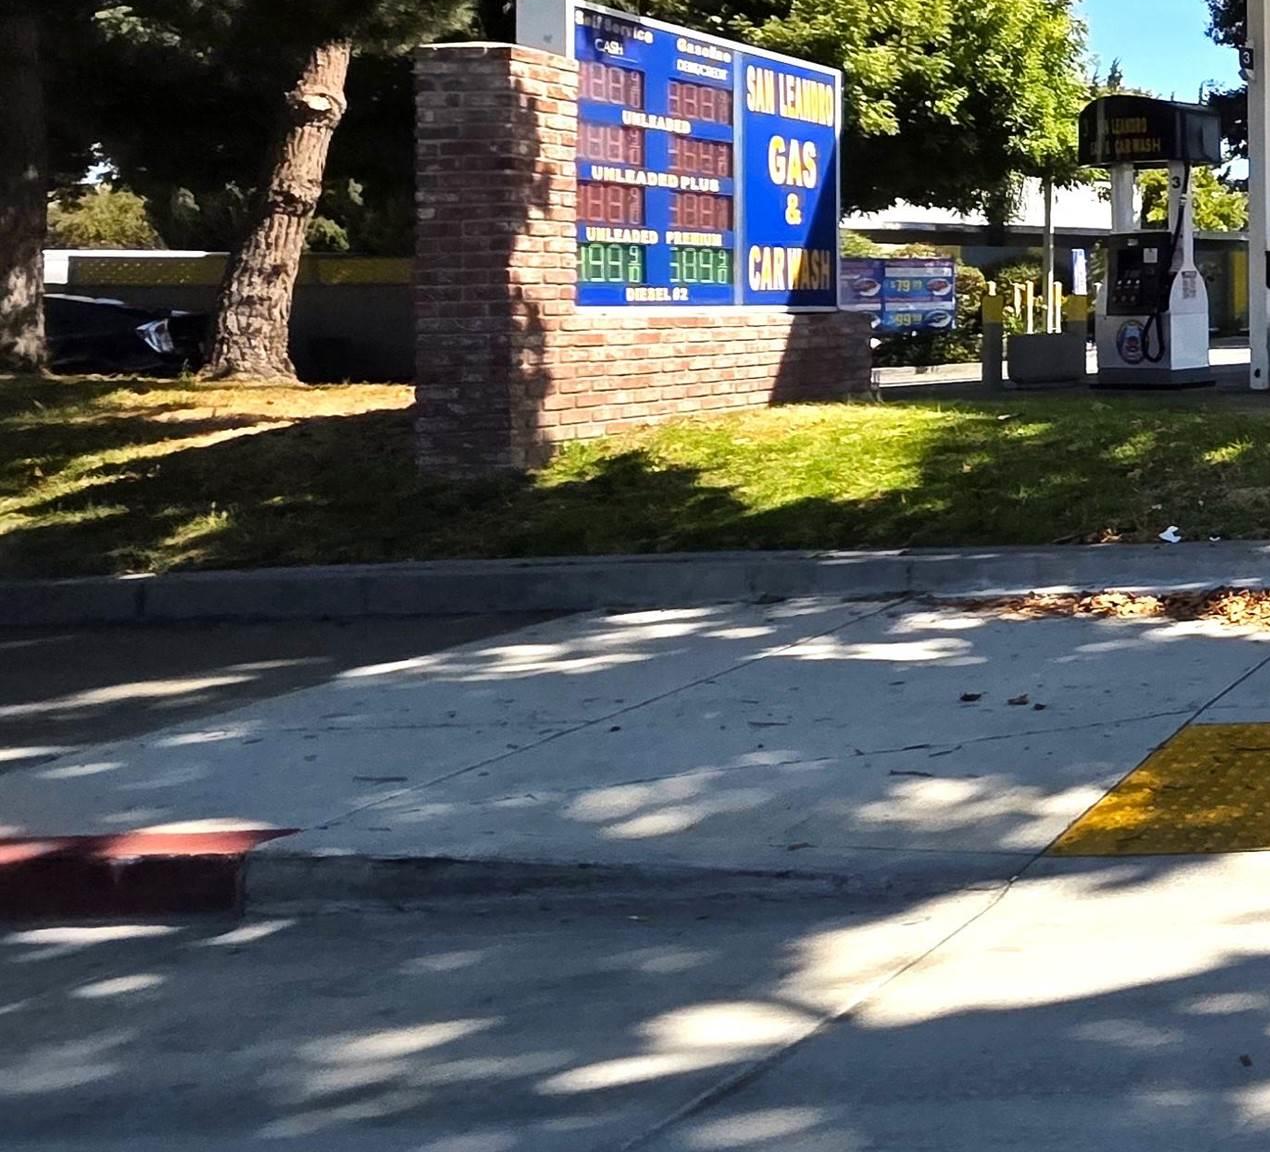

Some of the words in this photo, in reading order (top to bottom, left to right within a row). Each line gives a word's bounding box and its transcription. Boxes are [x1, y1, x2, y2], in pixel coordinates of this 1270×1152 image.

[575, 10, 603, 29] Self
[604, 17, 654, 44] Service
[594, 38, 624, 56] CASH
[676, 37, 732, 64] Gasoline
[1242, 51, 1250, 64] 3
[746, 64, 775, 115] SAN
[778, 72, 834, 127] LEANDRO
[621, 109, 691, 135] UNLEADED
[768, 135, 817, 189] GAS
[591, 165, 679, 189] UNLEADED
[680, 175, 720, 192] PLUS
[1171, 175, 1181, 189] 3
[785, 193, 802, 225] &
[585, 226, 659, 244] UNLEADED
[665, 230, 723, 246] PREMIUM
[748, 244, 785, 291] CAR
[786, 246, 831, 291] WASH
[626, 287, 671, 302] DIESEL
